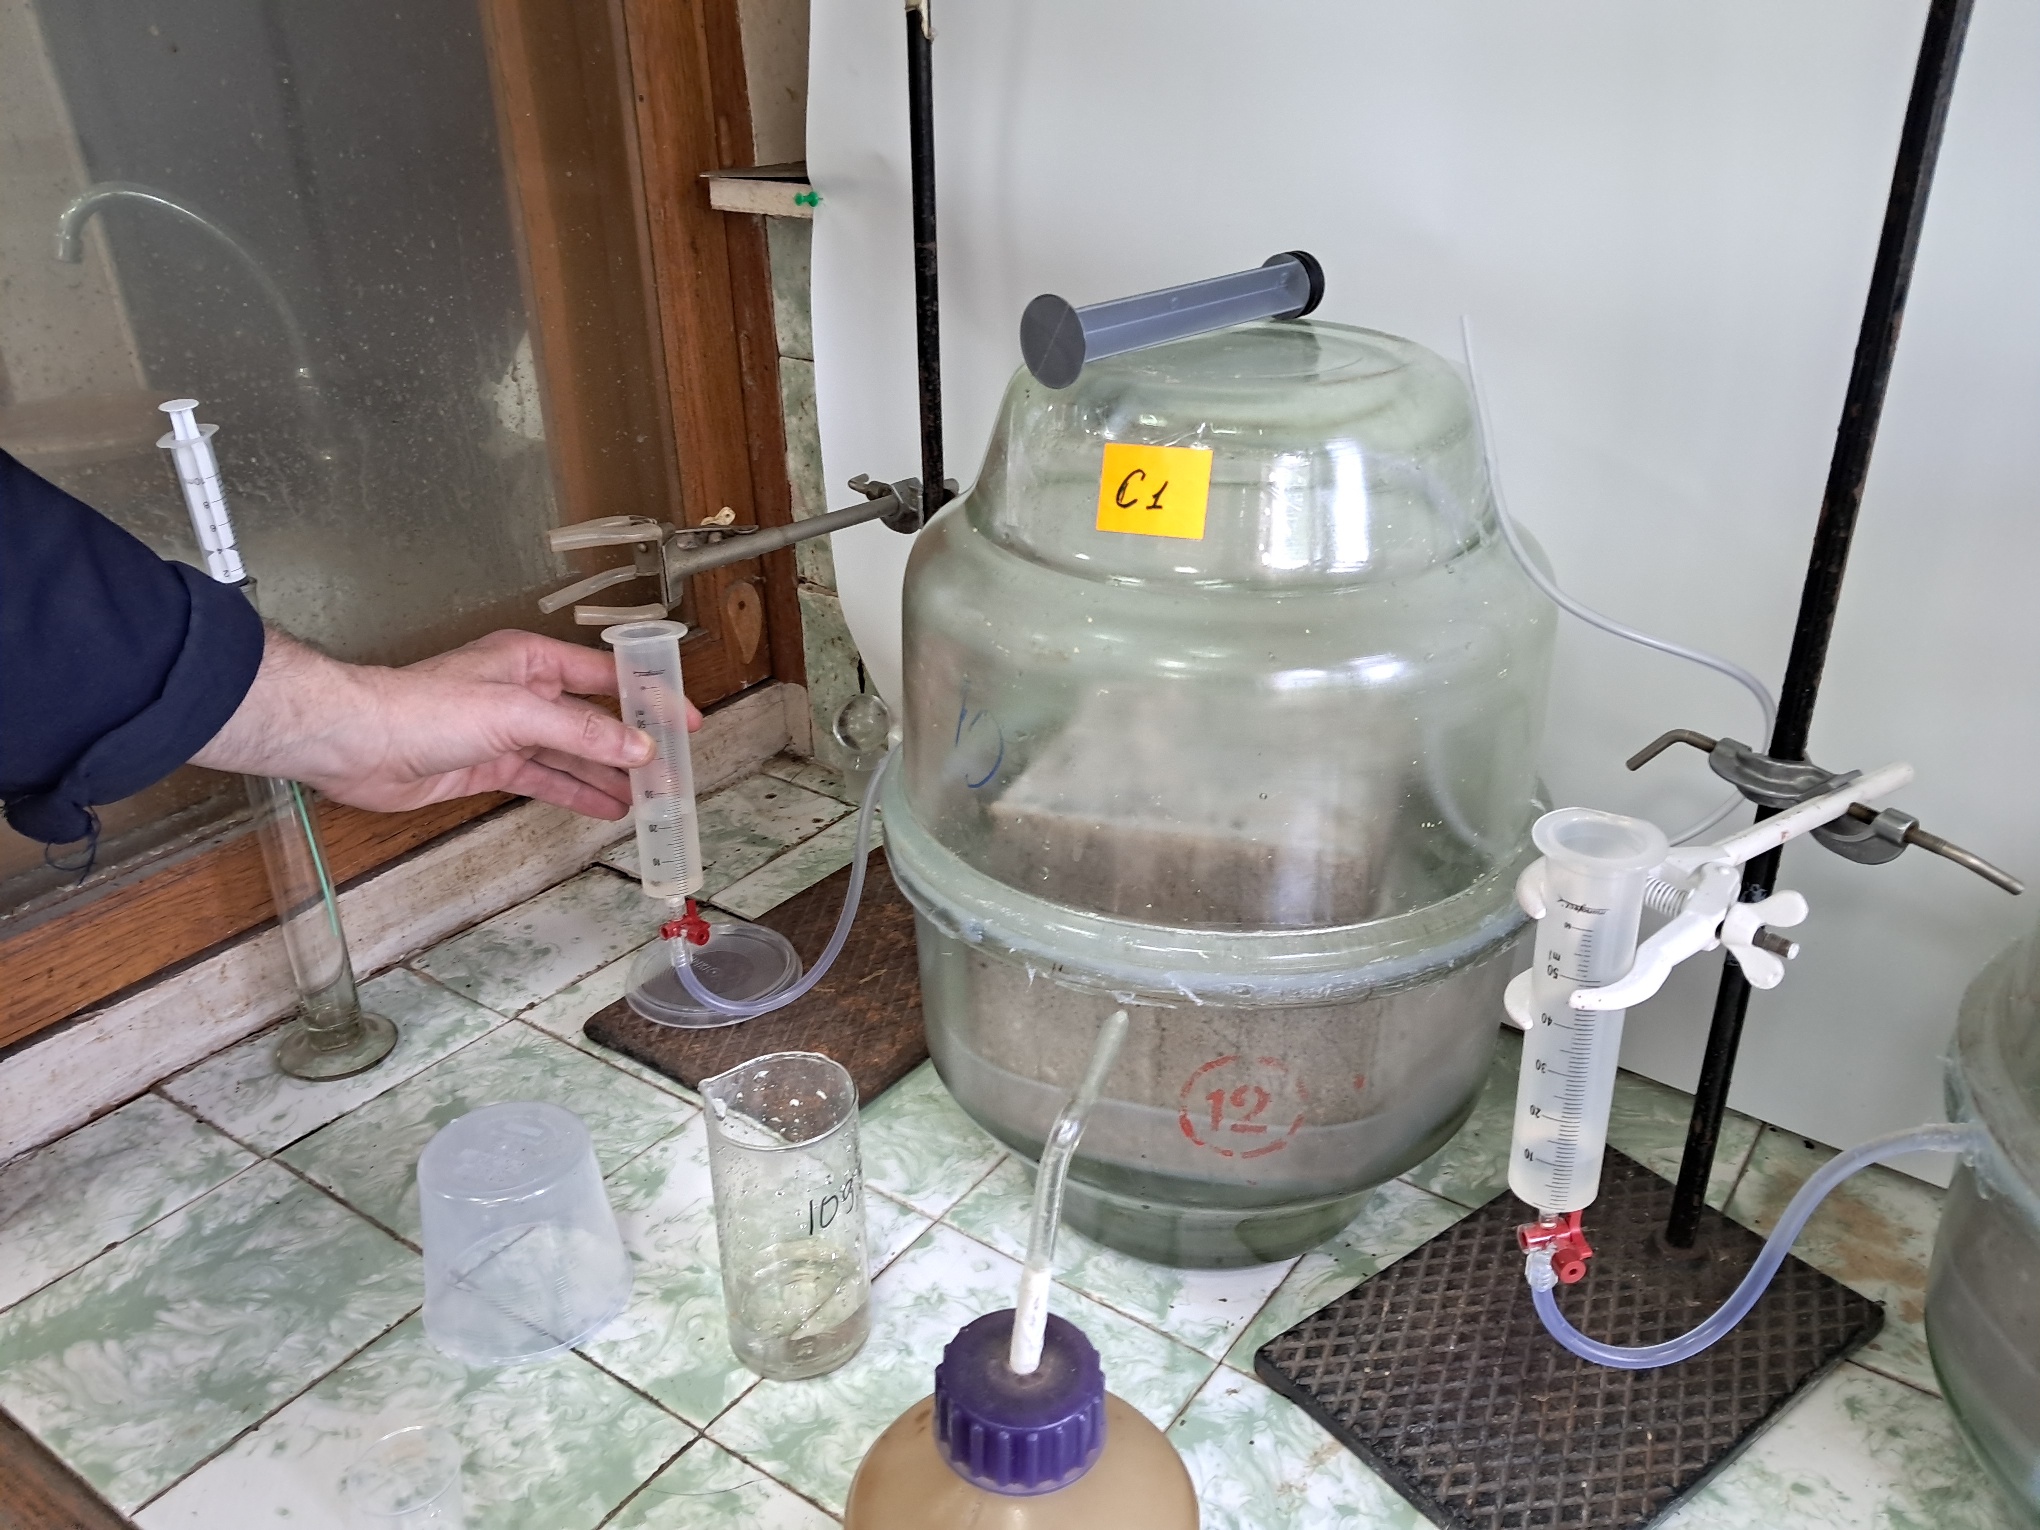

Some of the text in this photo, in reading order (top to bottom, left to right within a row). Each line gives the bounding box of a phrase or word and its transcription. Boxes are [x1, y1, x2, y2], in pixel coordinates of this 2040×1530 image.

[1115, 468, 1168, 510] C1
[1546, 964, 1559, 980] 50
[1541, 1012, 1553, 1027] 40
[1535, 1059, 1547, 1074] 30
[1205, 1084, 1271, 1134] 12
[1529, 1104, 1541, 1119] 20
[1524, 1148, 1534, 1162] 10
